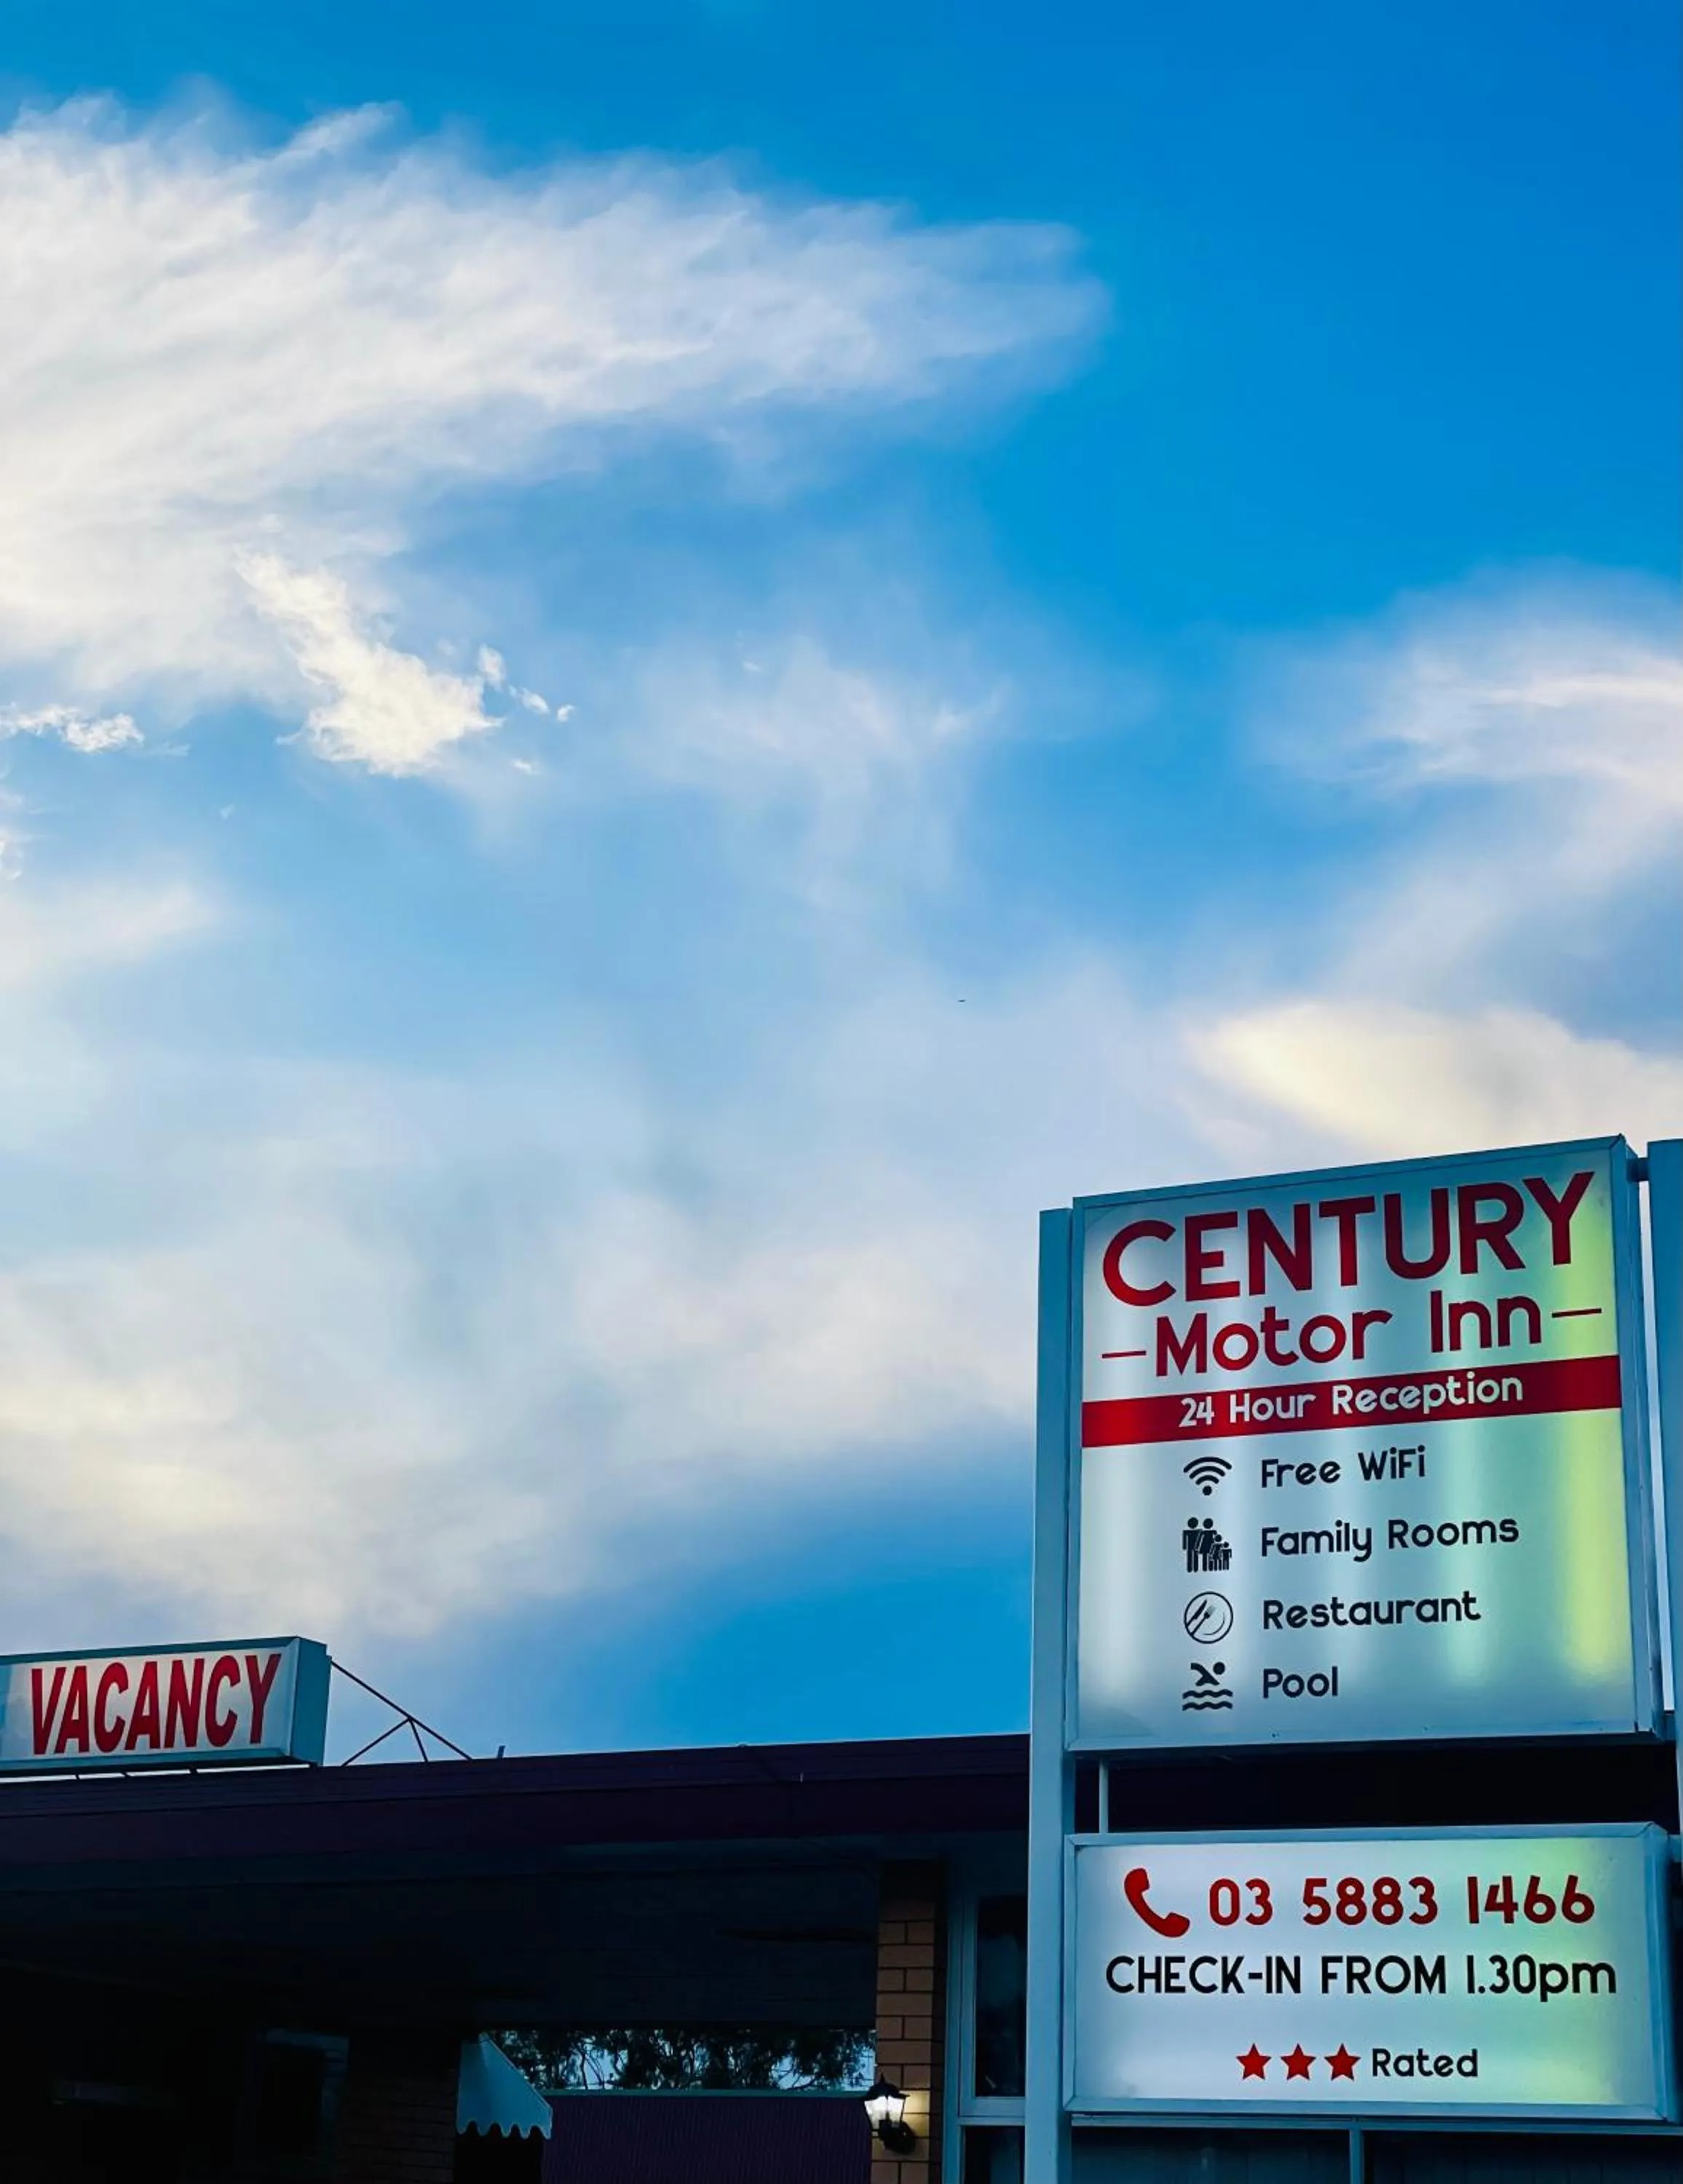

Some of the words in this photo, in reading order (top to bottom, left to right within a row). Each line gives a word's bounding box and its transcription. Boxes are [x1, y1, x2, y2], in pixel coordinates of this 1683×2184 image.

[1102, 1171, 1595, 1307] CENTURY
[1155, 1306, 1393, 1377] Motor
[1430, 1290, 1542, 1353] Inn
[1179, 1393, 1215, 1428] 24
[1229, 1390, 1315, 1423] Hour
[1333, 1372, 1524, 1415] Reception
[1261, 1457, 1341, 1488] Free
[1358, 1445, 1426, 1481] WiFi
[1261, 1519, 1373, 1562] Family
[1389, 1518, 1519, 1549] Rooms
[1263, 1591, 1481, 1631] Restaurant
[31, 1653, 282, 1755] VACANCY
[1263, 1666, 1339, 1699] Pool
[1208, 1878, 1273, 1926] 03
[1302, 1876, 1438, 1926] 5883
[1467, 1875, 1596, 1925] 1466
[1106, 1955, 1302, 1994] CHECK-IN
[1321, 1955, 1447, 1994] FROM
[1467, 1954, 1617, 2002] 1.30pm
[1372, 2048, 1478, 2078] Rated
